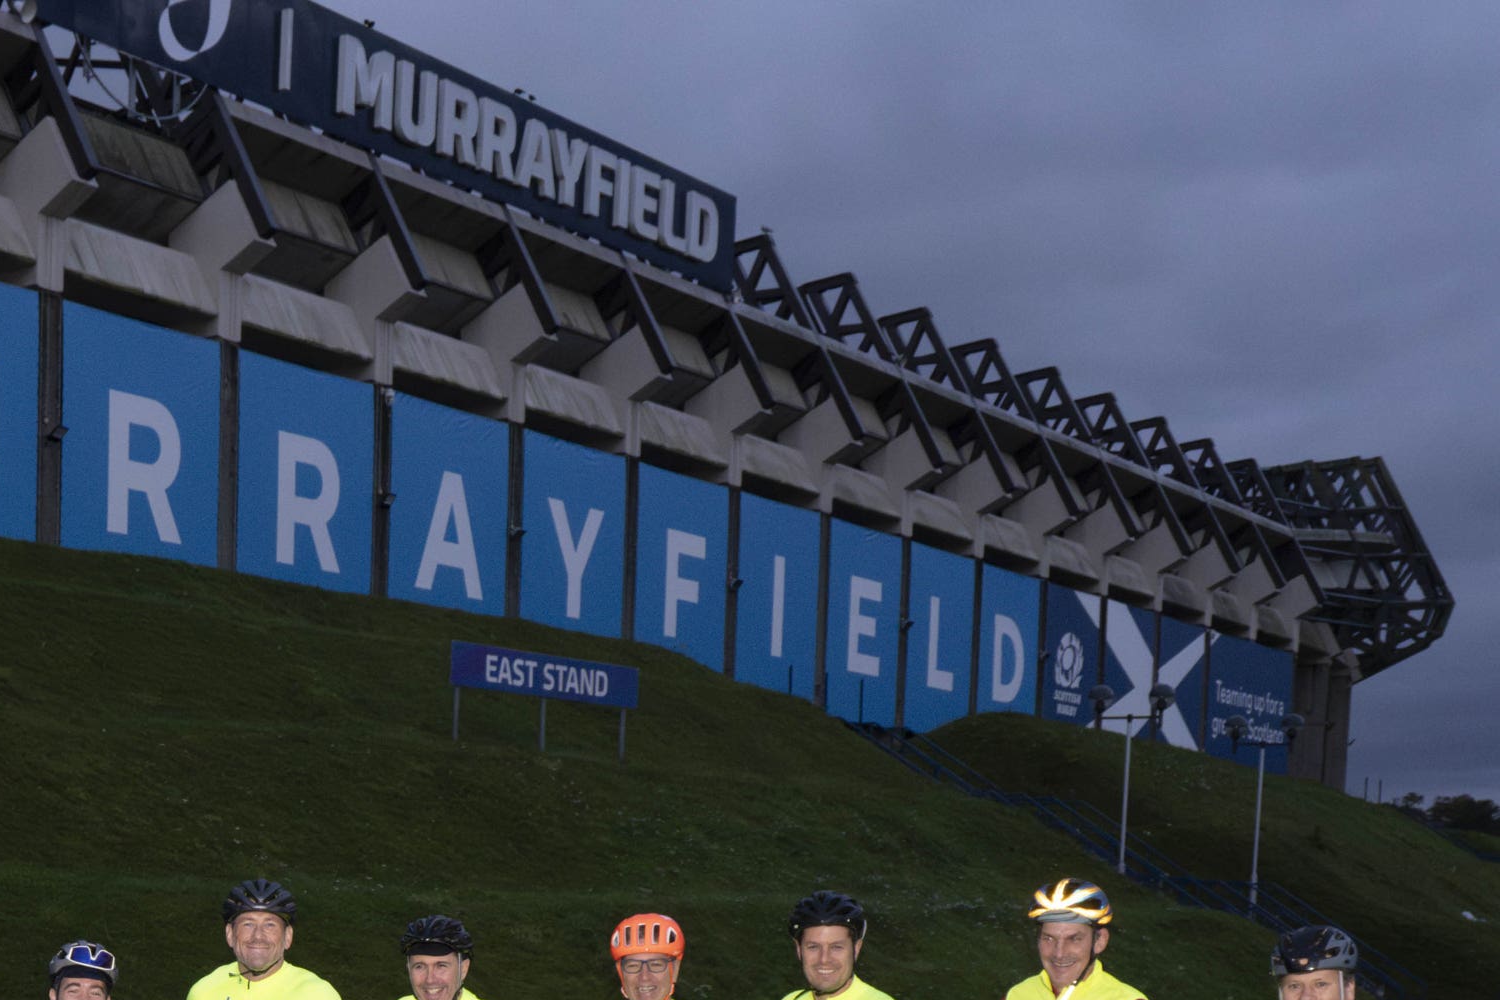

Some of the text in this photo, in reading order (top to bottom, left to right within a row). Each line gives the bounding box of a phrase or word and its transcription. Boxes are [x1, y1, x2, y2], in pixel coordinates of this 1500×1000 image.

[336, 32, 720, 263] MURRAYFIELD
[485, 653, 609, 697] EAST STAND
[1216, 680, 1252, 714] Teaming
[1248, 718, 1284, 744] Scotland
